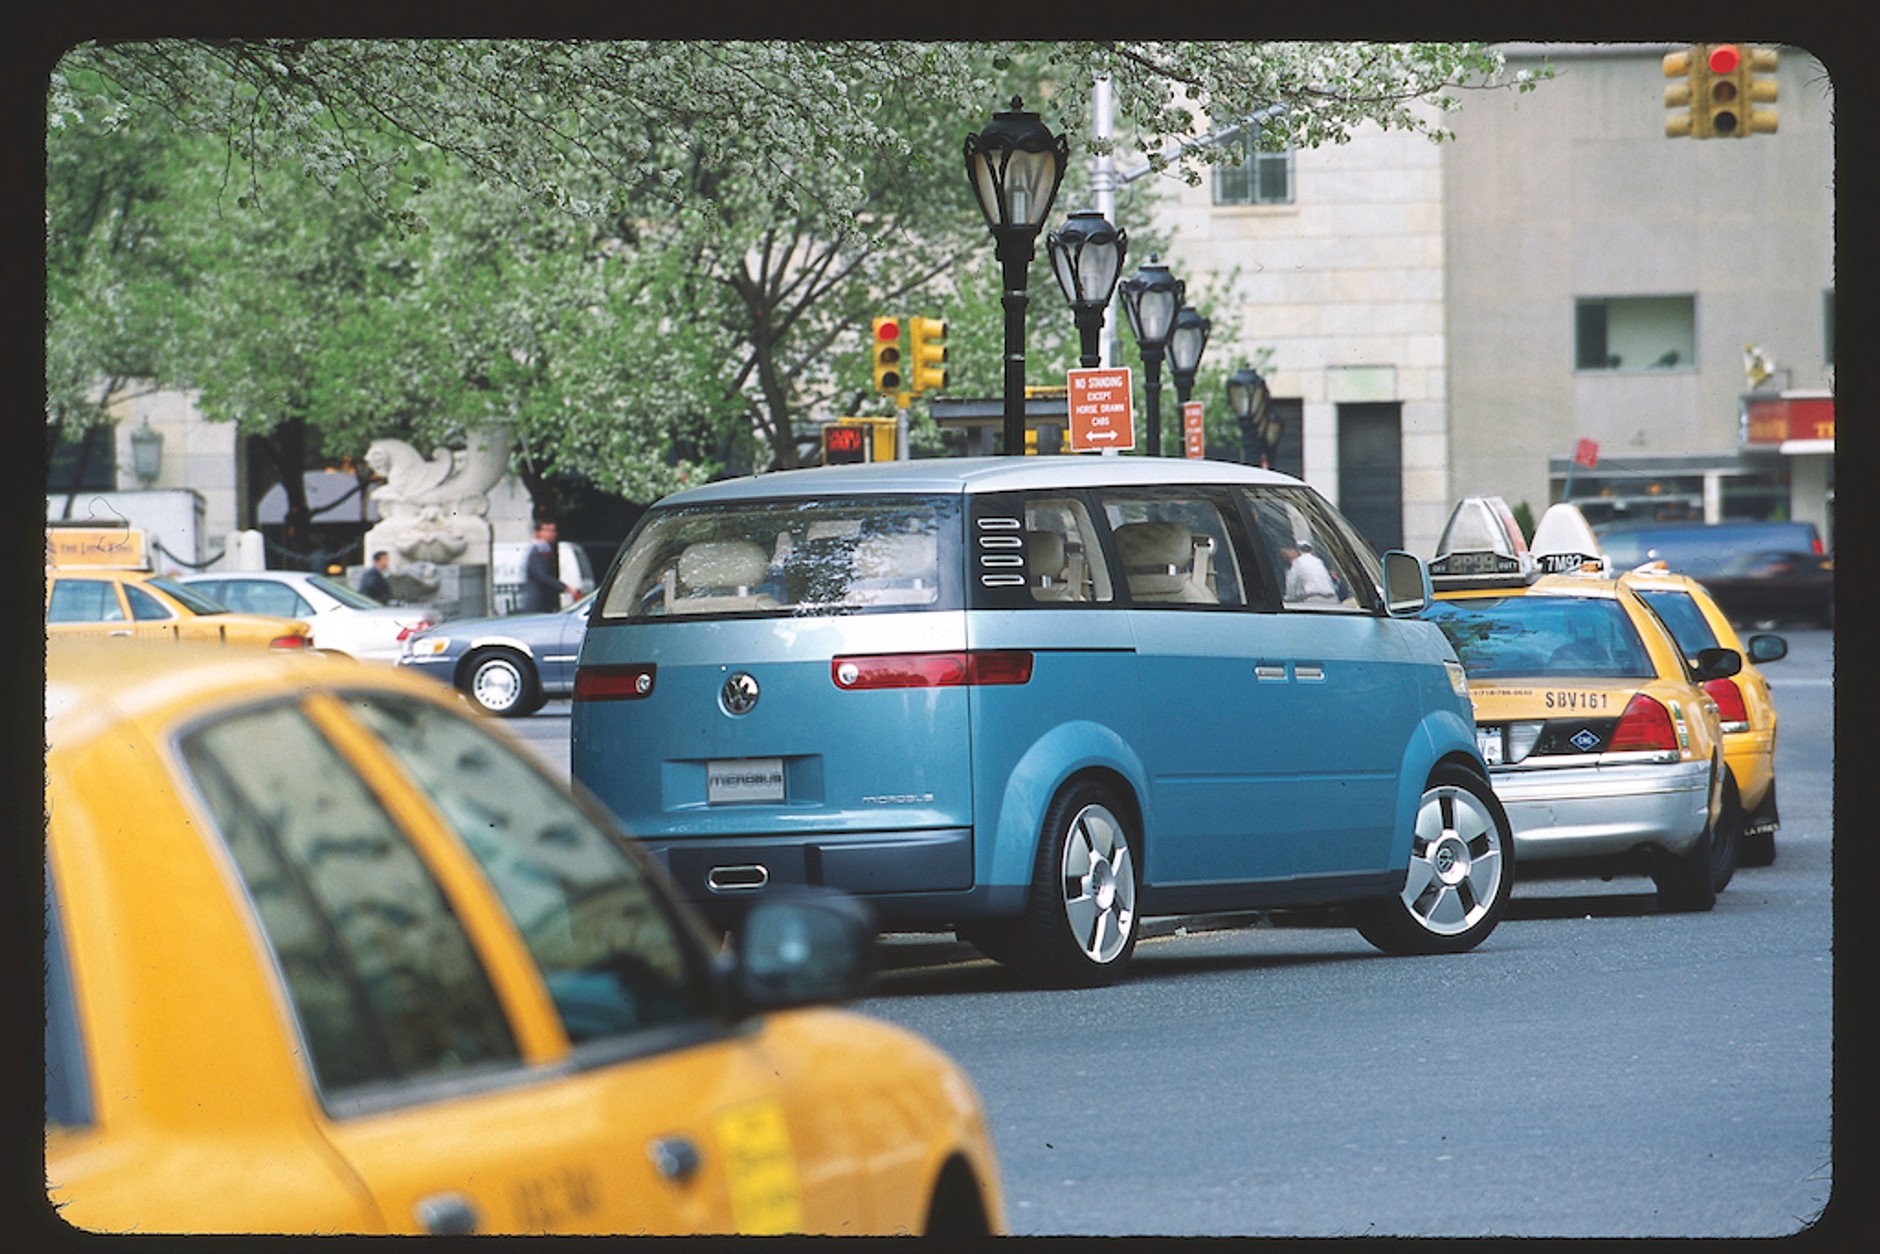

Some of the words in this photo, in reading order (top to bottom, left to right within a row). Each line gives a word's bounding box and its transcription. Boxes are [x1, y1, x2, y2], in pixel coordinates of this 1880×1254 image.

[1074, 378, 1086, 389] NO
[1088, 376, 1123, 388] STANDING
[1087, 391, 1112, 401] EXCEPT
[1075, 404, 1099, 414] HORSE
[1100, 403, 1125, 413] DRAWN
[1090, 417, 1110, 427] CABS
[61, 544, 78, 552] THE
[1546, 555, 1582, 572] 7M92
[1545, 692, 1608, 709] SBV161
